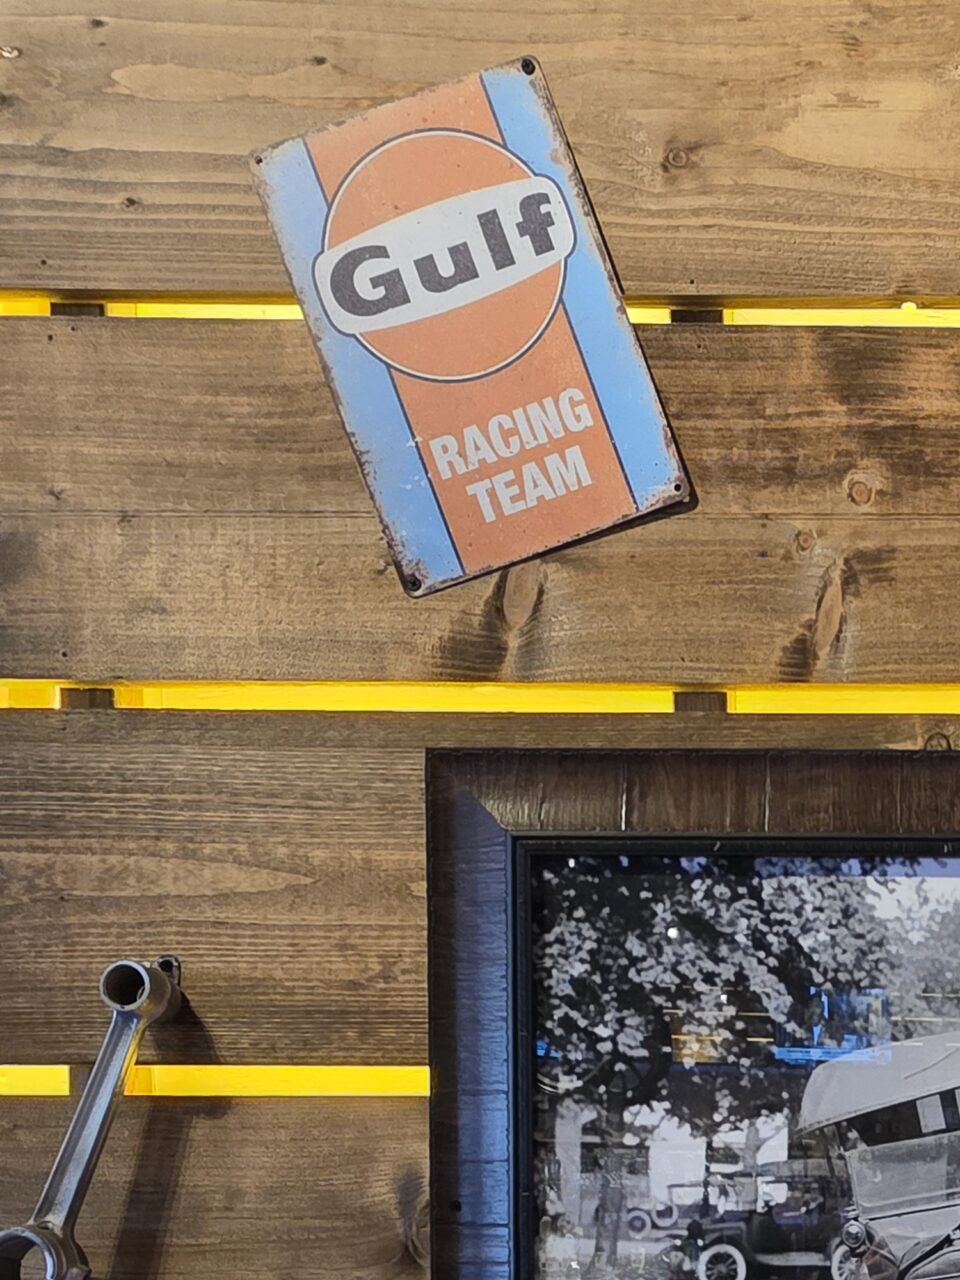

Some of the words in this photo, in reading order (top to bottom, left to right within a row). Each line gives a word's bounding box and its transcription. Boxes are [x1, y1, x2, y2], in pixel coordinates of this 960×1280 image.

[329, 192, 555, 317] Gulf
[429, 387, 593, 480] RACING
[466, 445, 592, 523] TEAM
